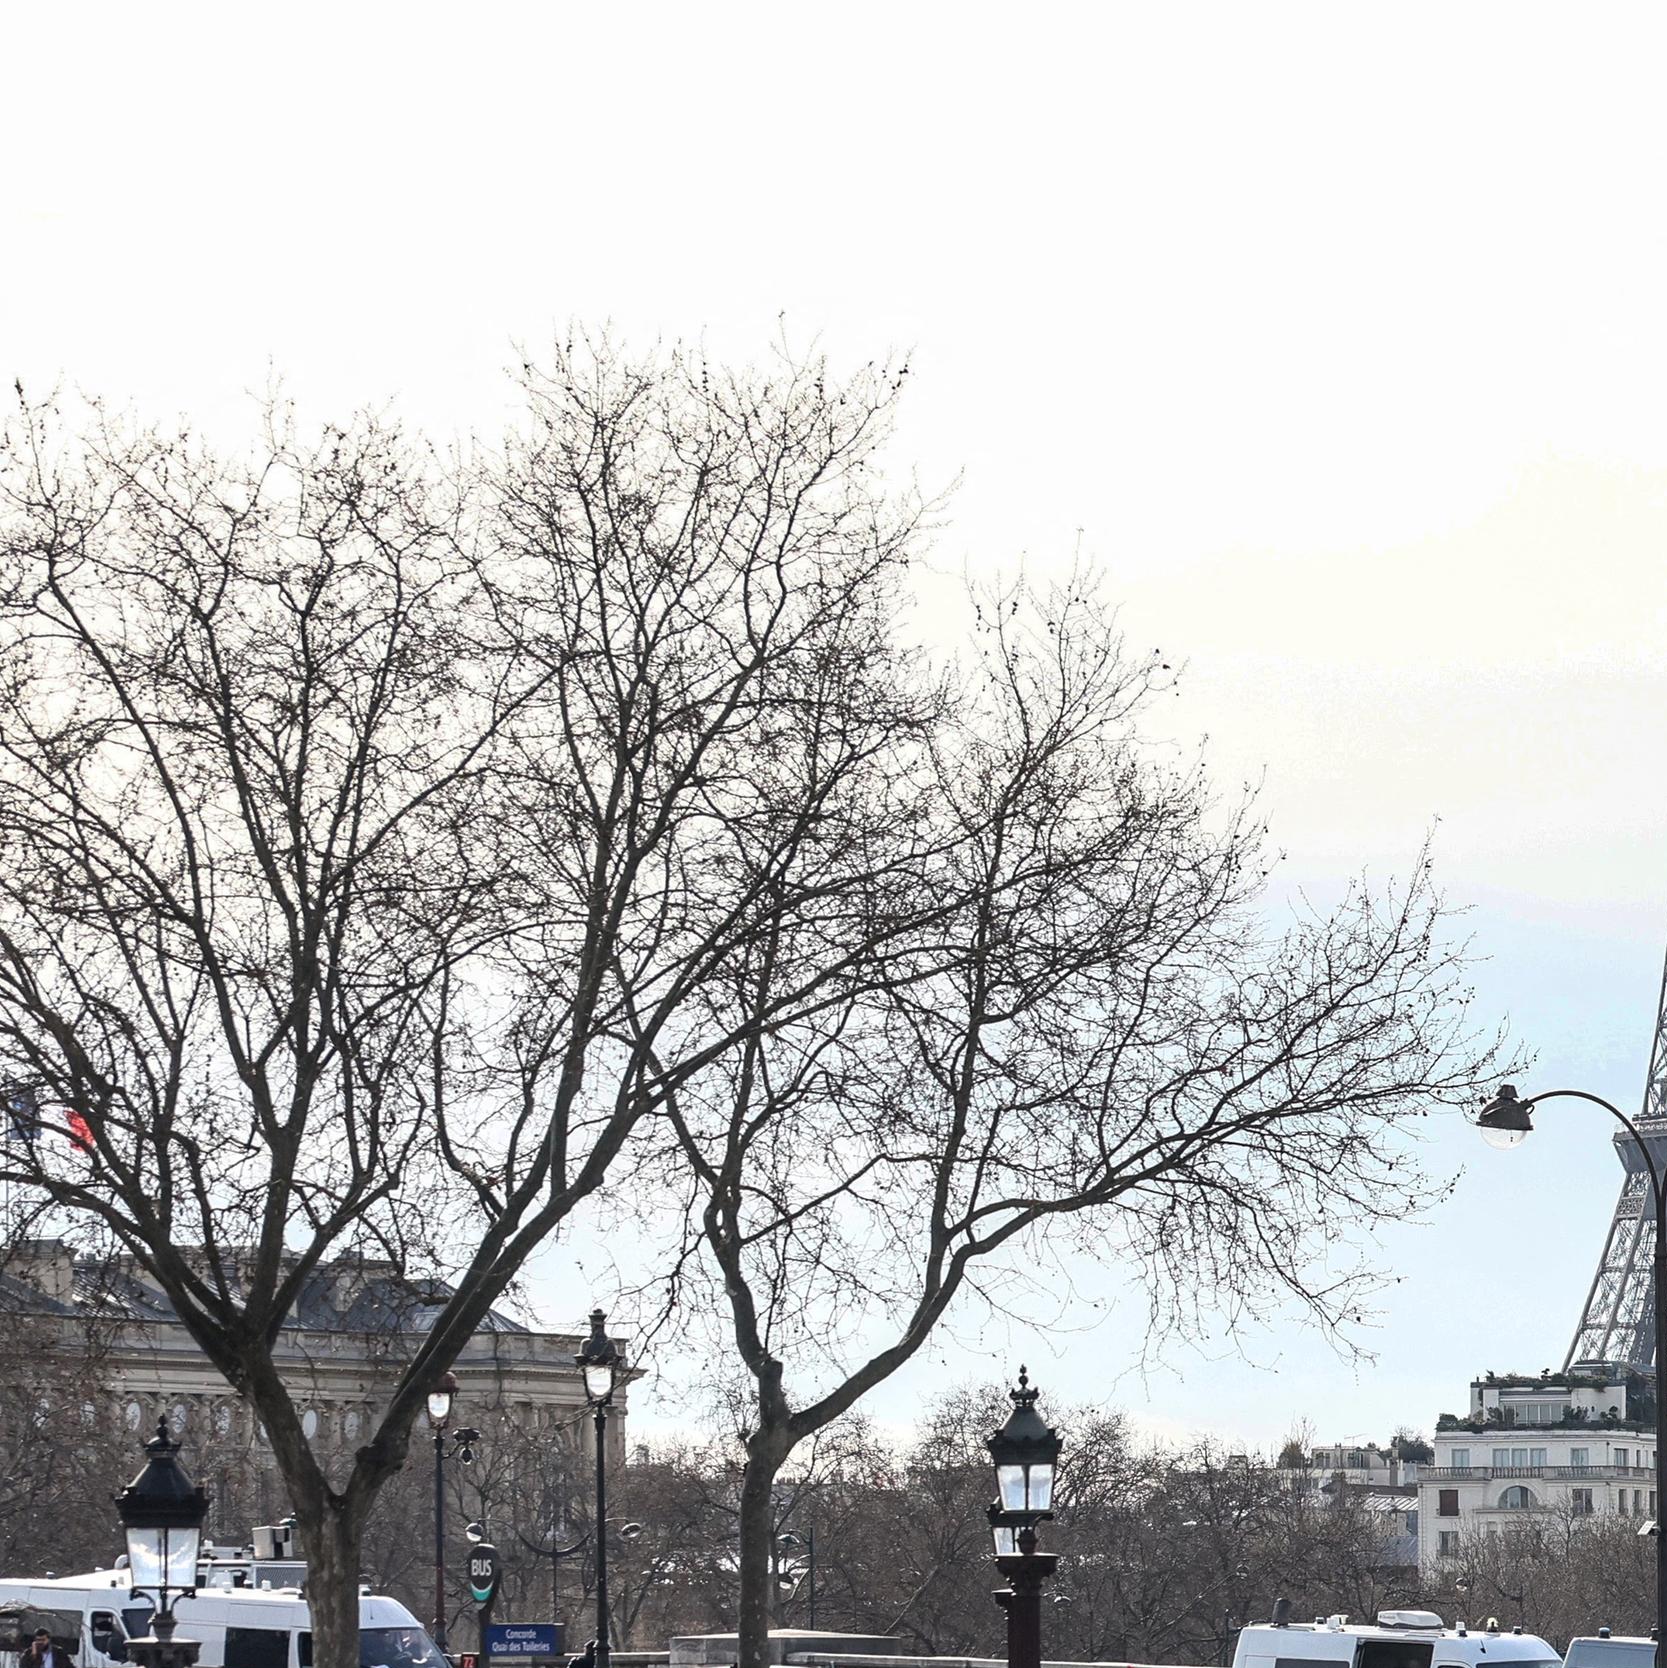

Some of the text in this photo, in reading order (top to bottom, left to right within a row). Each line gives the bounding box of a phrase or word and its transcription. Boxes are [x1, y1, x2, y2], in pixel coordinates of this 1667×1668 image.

[471, 1559, 492, 1576] BUS
[505, 1628, 537, 1639] Concorde
[509, 1641, 520, 1651] des
[463, 1656, 474, 1668] 72
